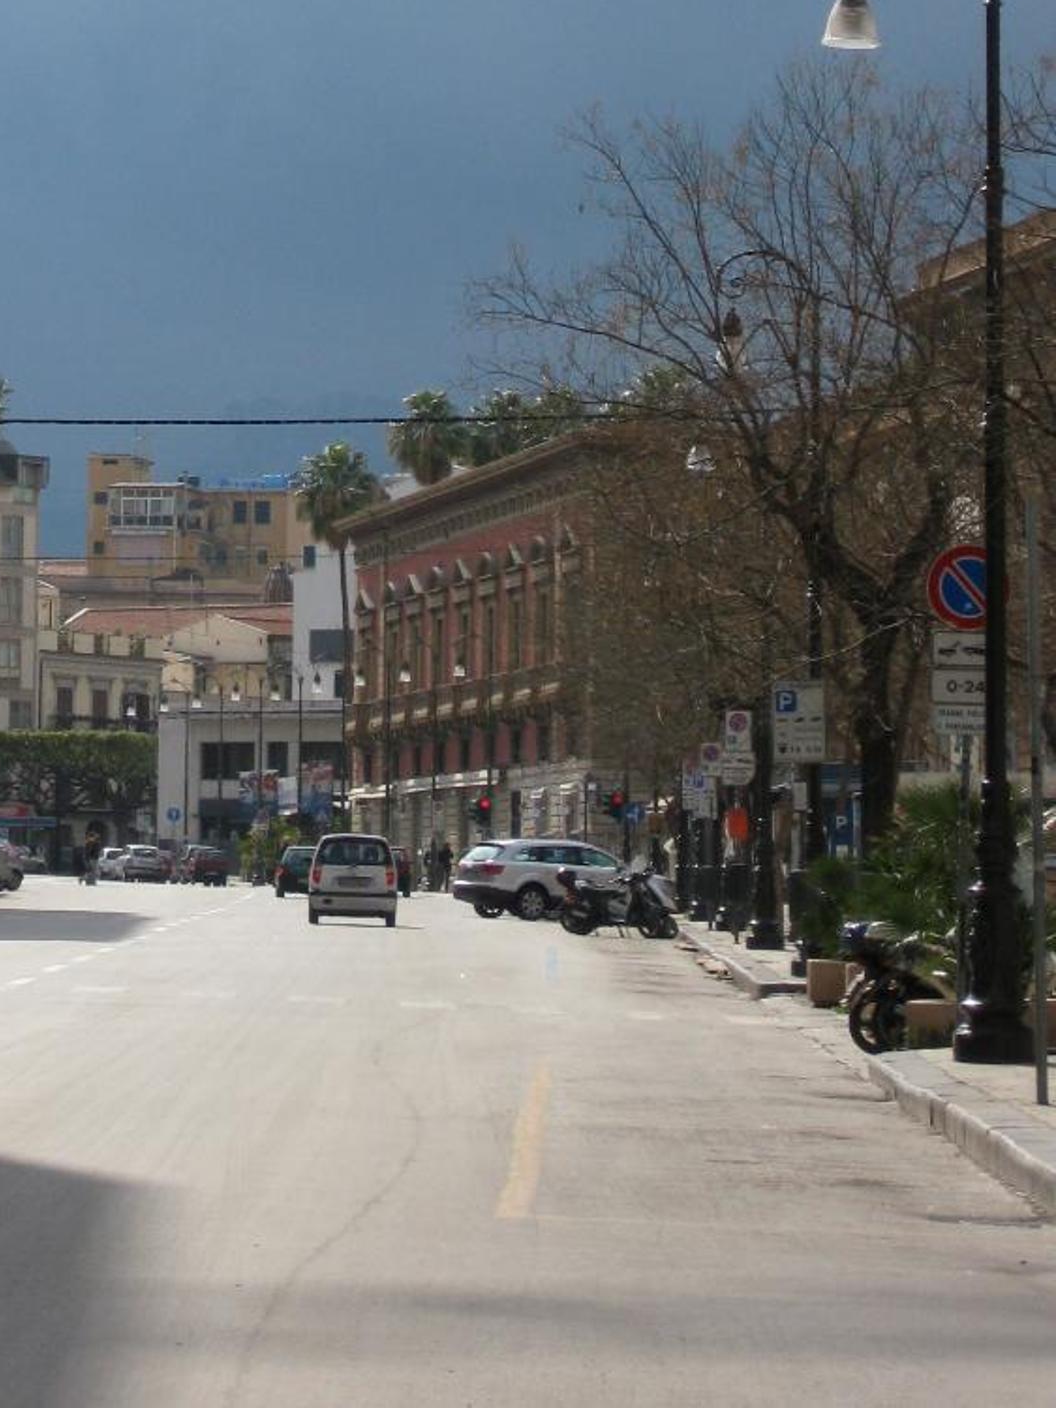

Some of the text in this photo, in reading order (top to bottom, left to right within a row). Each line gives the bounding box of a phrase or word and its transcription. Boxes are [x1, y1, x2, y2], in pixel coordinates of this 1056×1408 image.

[946, 679, 985, 694] 0-24
[779, 692, 792, 710] P
[836, 816, 847, 829] P
